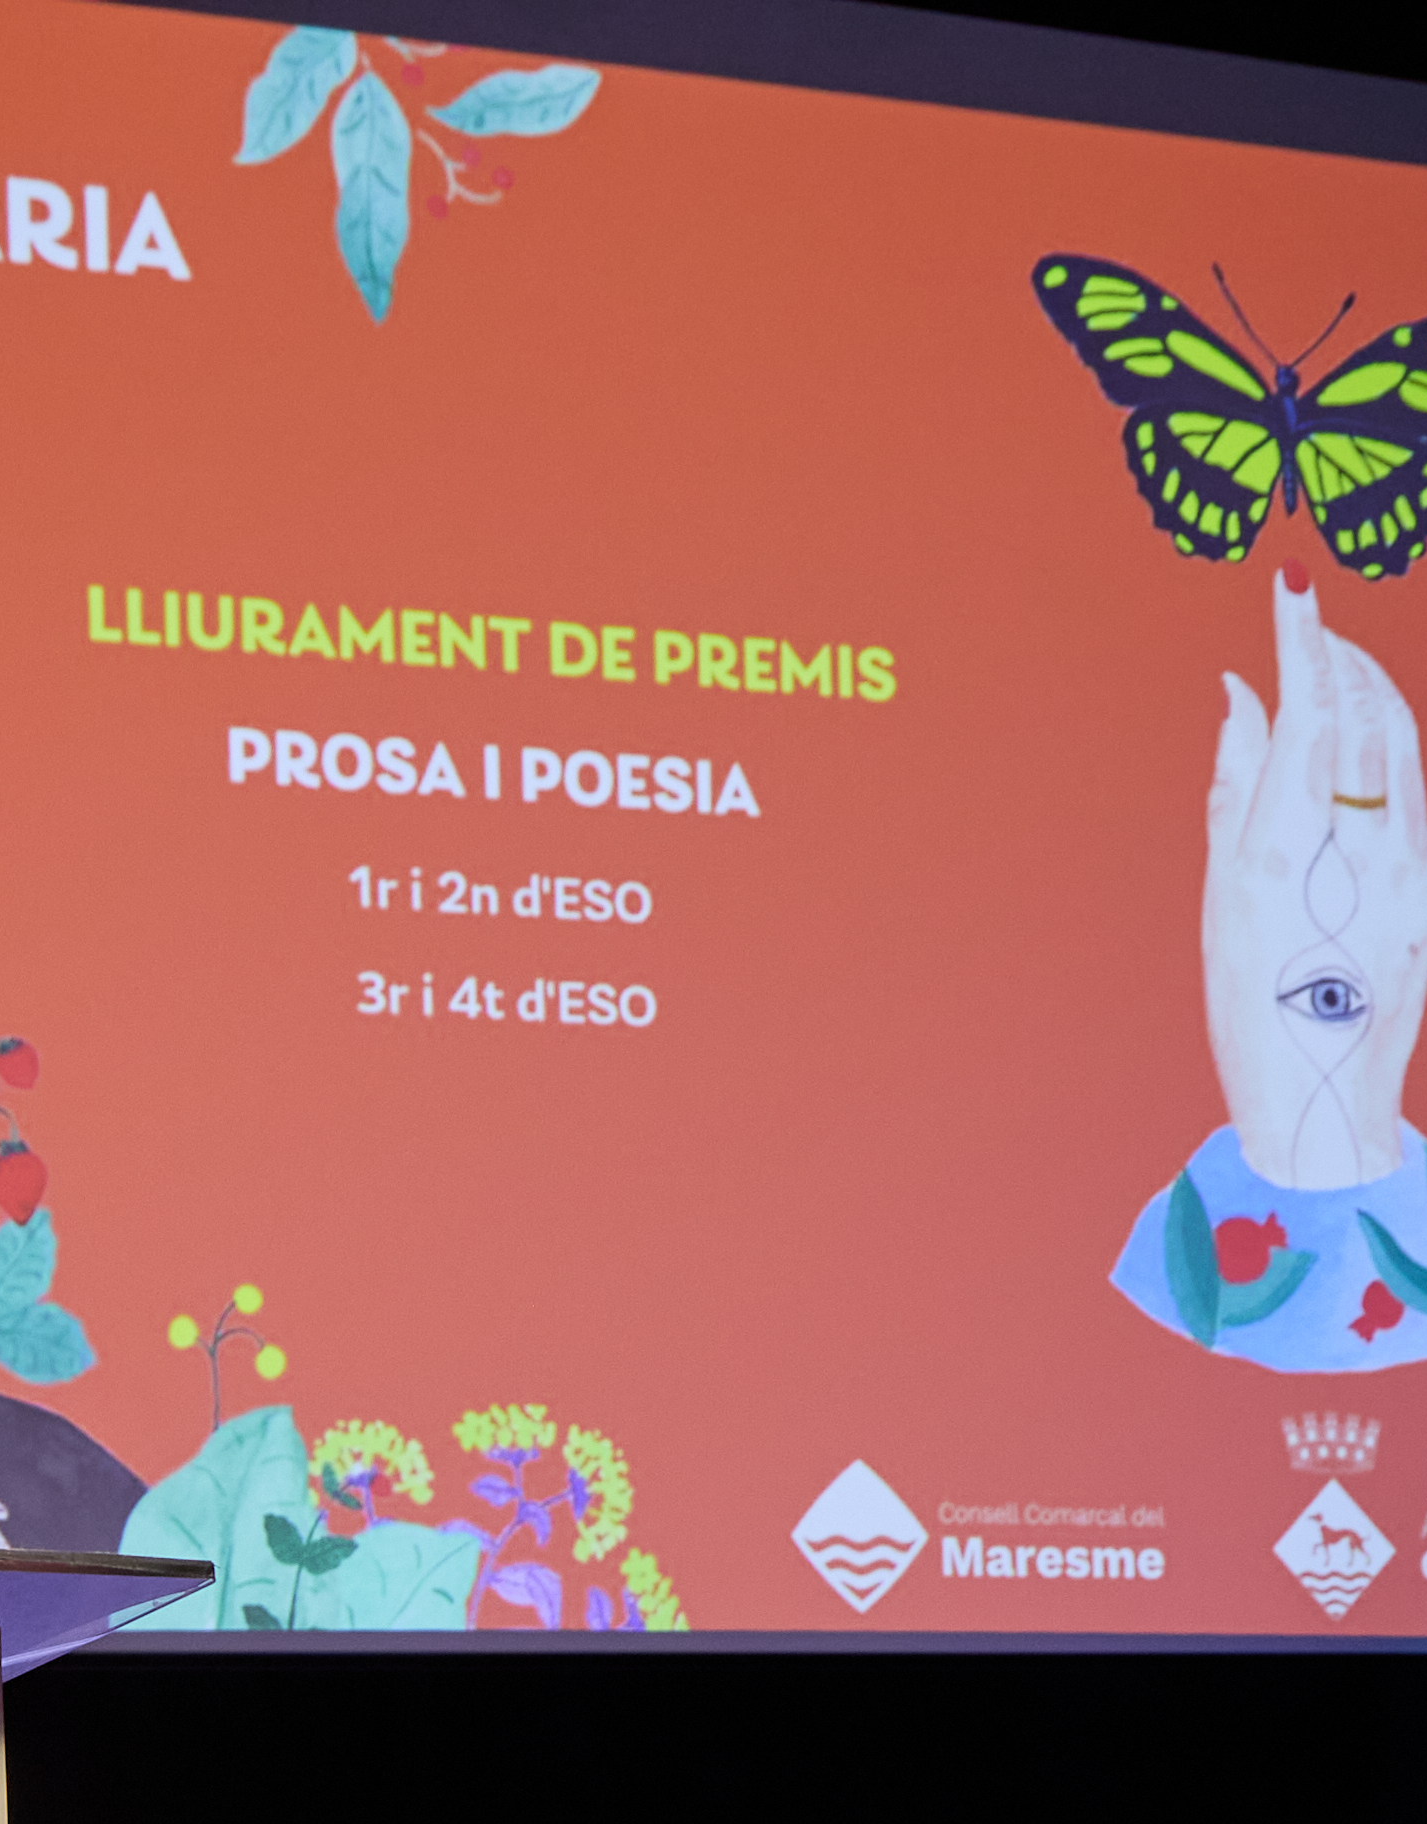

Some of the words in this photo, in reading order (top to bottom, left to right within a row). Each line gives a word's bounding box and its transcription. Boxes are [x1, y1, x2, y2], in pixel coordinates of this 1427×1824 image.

[87, 584, 532, 673] LLIURAMENT
[549, 620, 637, 682] DE
[653, 629, 897, 702] PREMIS
[227, 726, 466, 798] PROSA
[483, 744, 501, 800] I
[520, 747, 760, 818] POESIA
[348, 865, 398, 910] 1r
[410, 866, 422, 912] i
[437, 870, 499, 916] 2n
[511, 873, 652, 924] d'ESO
[357, 970, 409, 1016] 3r
[422, 972, 434, 1017] i
[447, 976, 505, 1021] 4t
[516, 978, 657, 1028] d'ESO
[937, 1501, 1021, 1525] Consell
[1023, 1503, 1127, 1527] Comarcal
[1130, 1506, 1165, 1528] del
[940, 1536, 1165, 1580] Maresme
